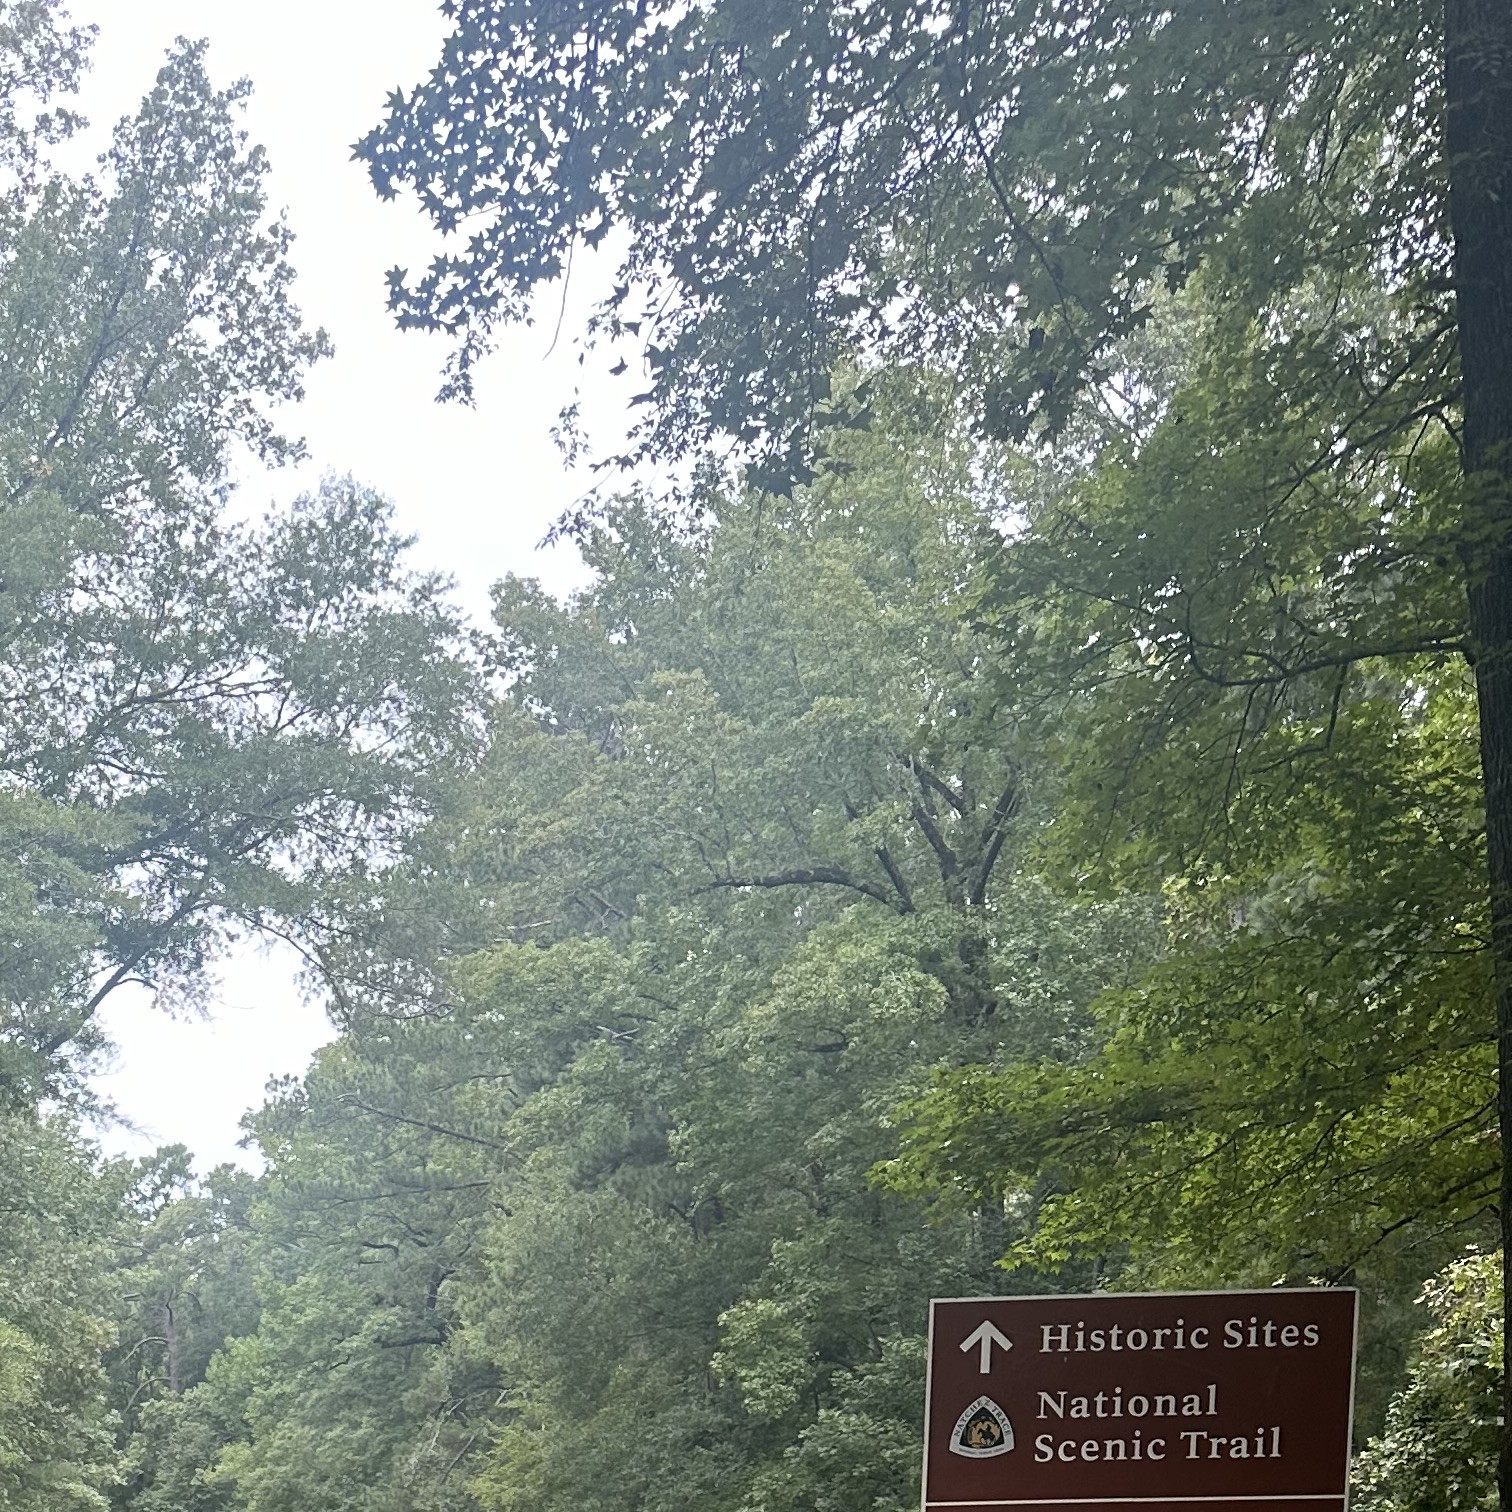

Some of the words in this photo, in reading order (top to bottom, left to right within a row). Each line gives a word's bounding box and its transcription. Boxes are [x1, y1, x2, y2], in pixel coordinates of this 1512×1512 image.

[1039, 1318, 1209, 1353] Historic
[1223, 1316, 1319, 1348] Sites
[1036, 1383, 1218, 1419] National
[991, 1405, 1012, 1438] TRACE
[1034, 1429, 1166, 1463] Scenic
[1179, 1426, 1281, 1459] Trail
